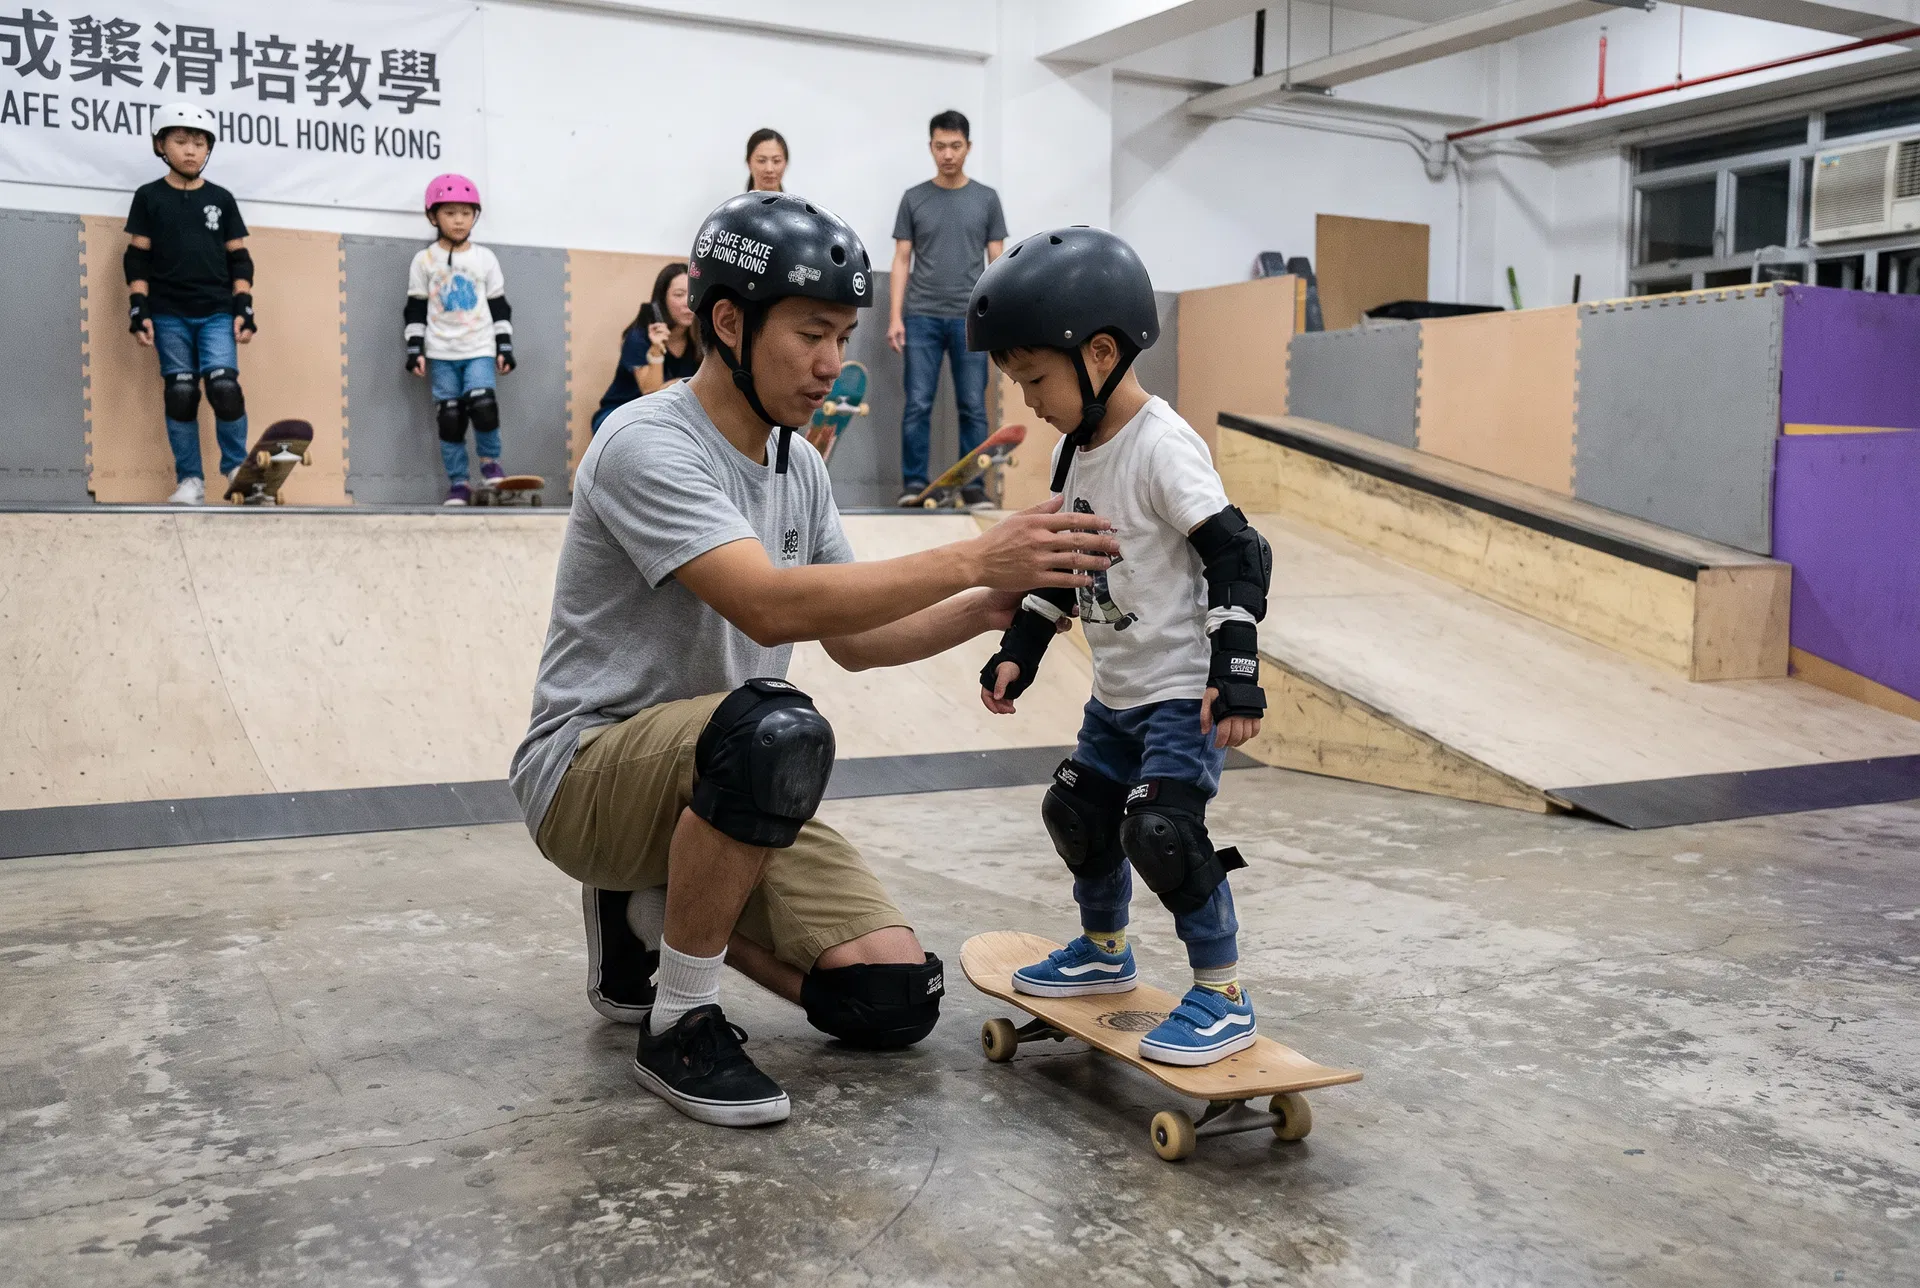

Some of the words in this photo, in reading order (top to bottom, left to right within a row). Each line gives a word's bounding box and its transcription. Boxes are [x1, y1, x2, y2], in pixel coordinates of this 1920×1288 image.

[205, 109, 288, 148] HOOL
[297, 118, 365, 155] HONG
[375, 126, 441, 160] KONG
[712, 244, 737, 265] HONG
[738, 255, 767, 275] KONG
[717, 229, 739, 249] SAFE
[739, 237, 773, 260] SKATE
